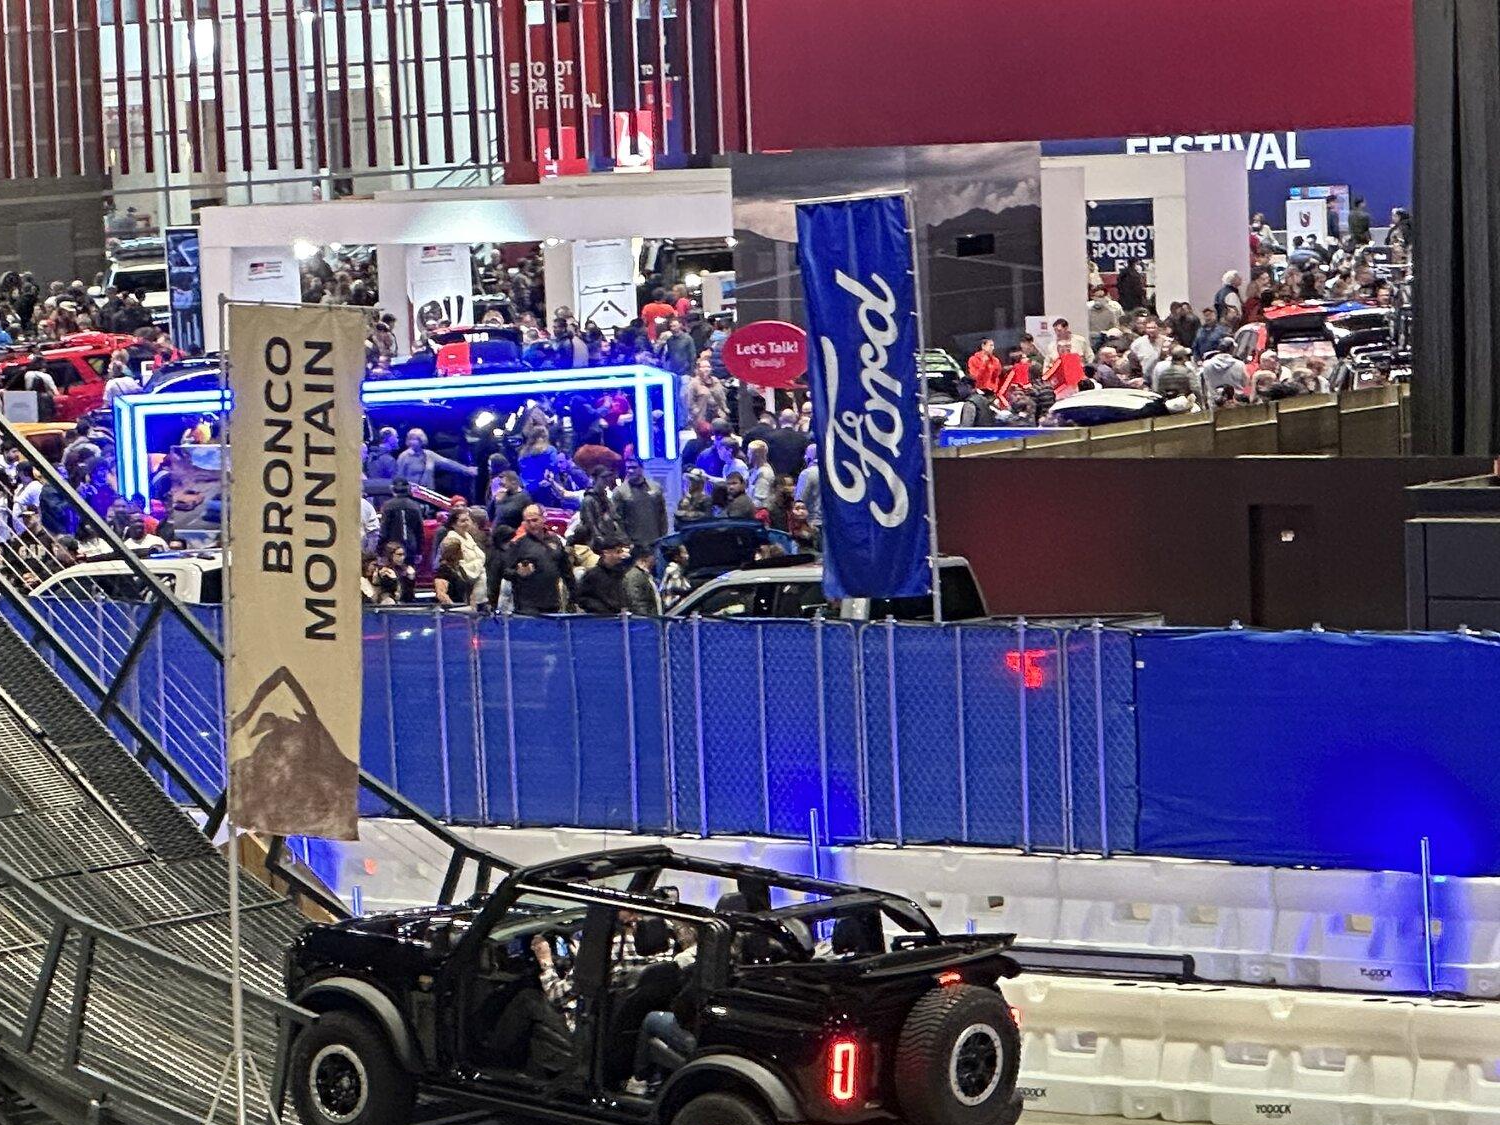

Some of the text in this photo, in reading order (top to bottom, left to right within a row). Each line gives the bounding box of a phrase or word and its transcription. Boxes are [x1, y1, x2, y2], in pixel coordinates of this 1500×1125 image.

[736, 341, 799, 355] Let's Talk!
[1103, 225, 1155, 241] TOYOT
[262, 336, 294, 574] BRONCO
[304, 340, 337, 641] MOUNTAIN
[820, 269, 908, 528] Ford
